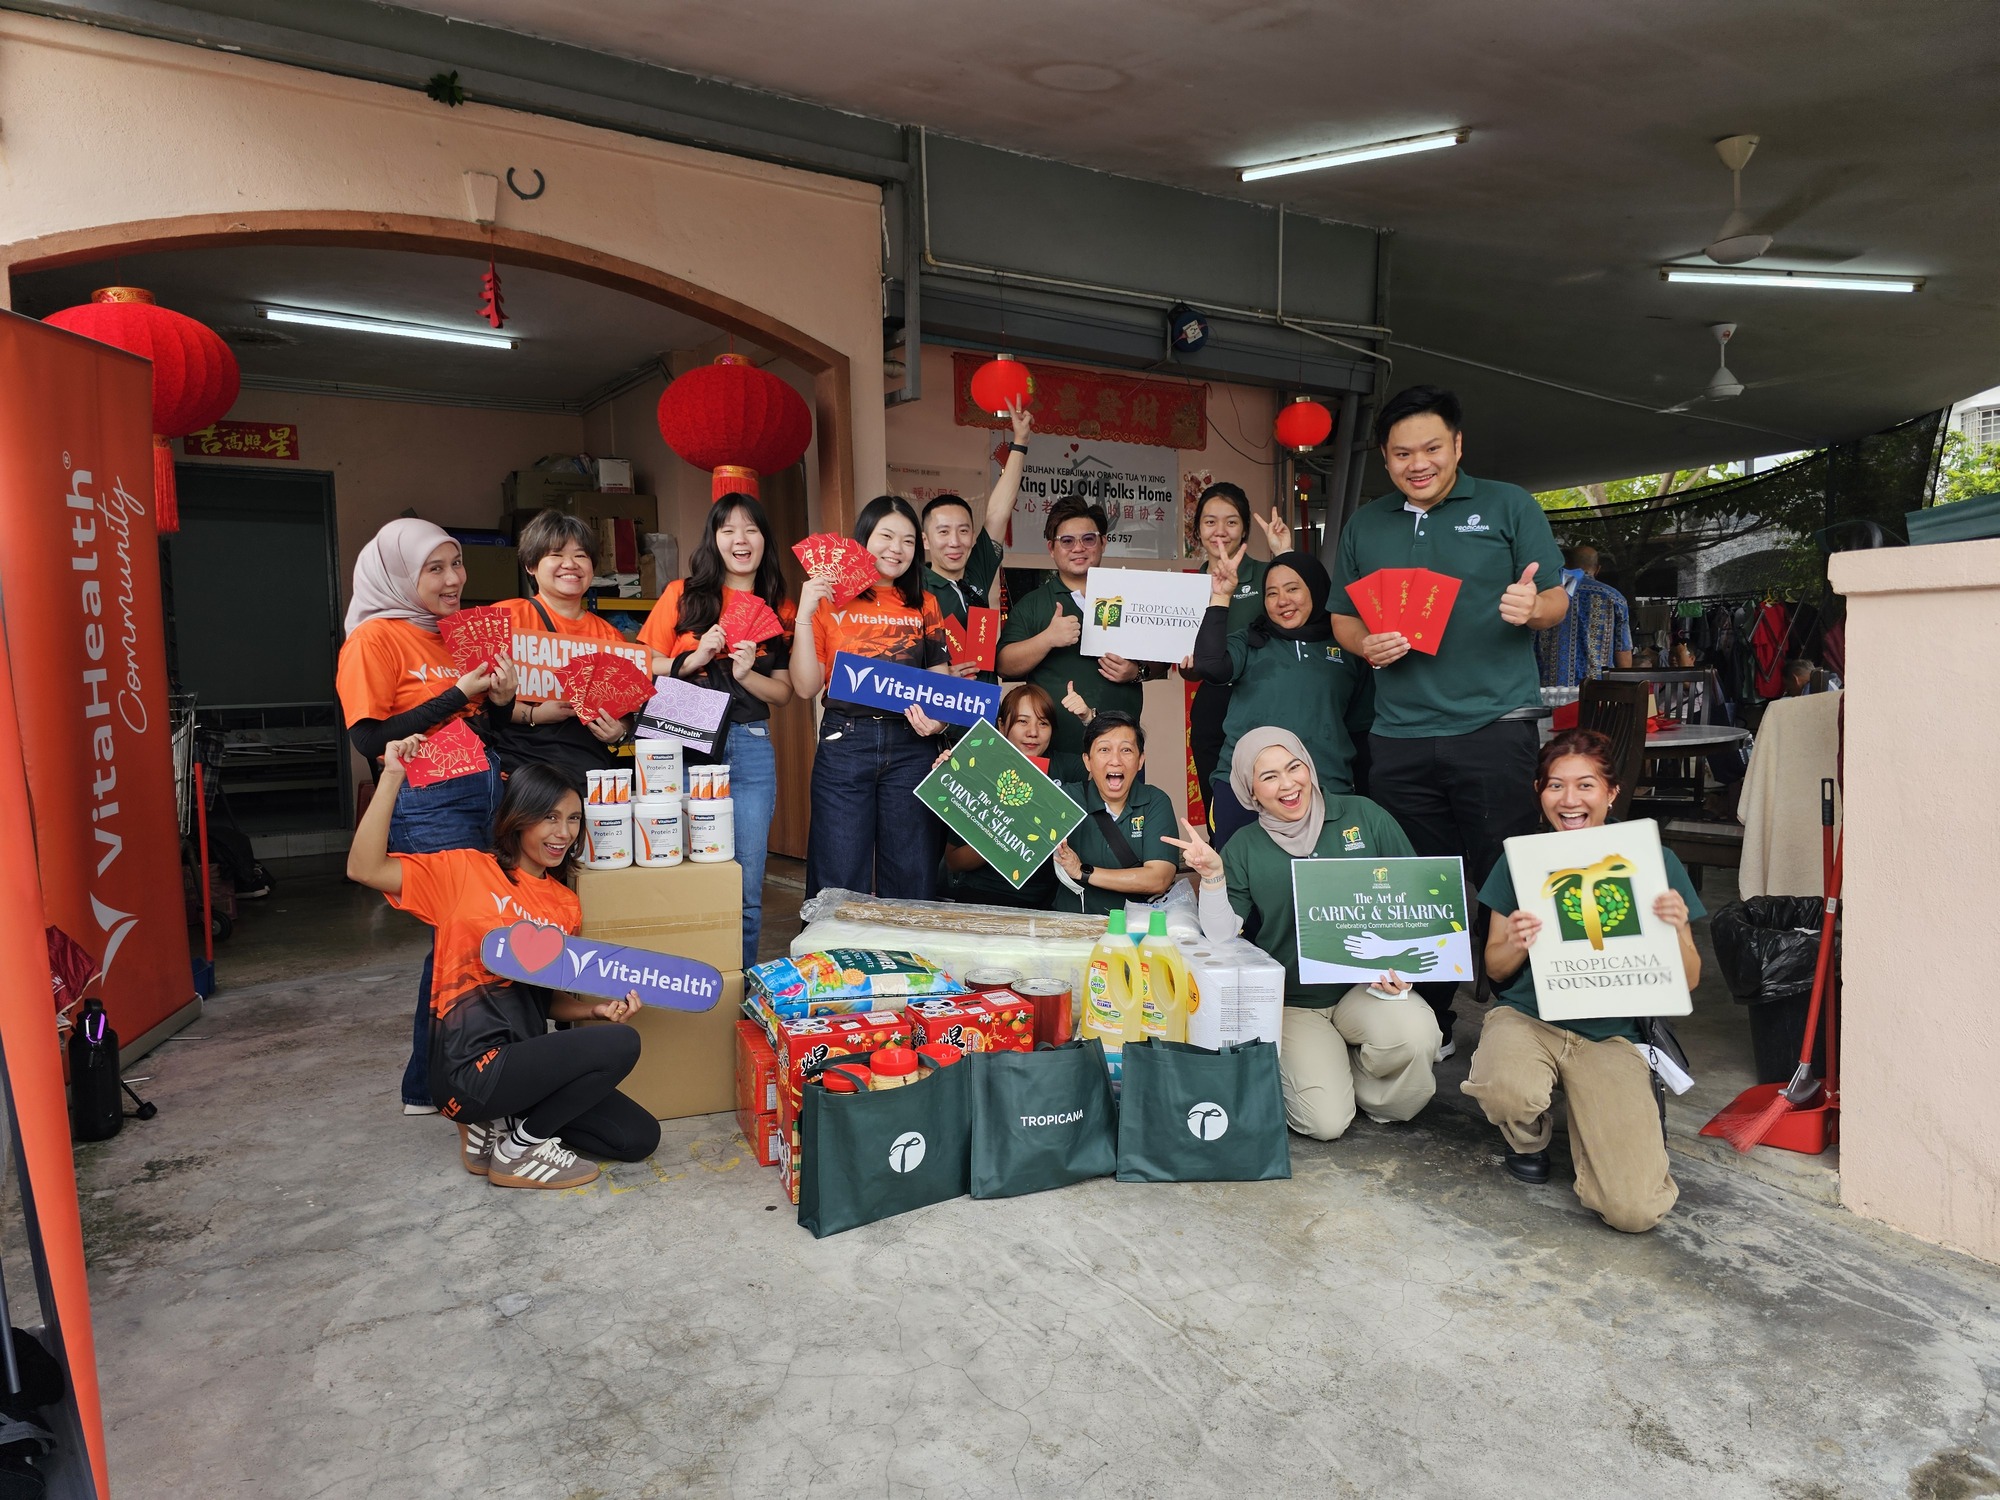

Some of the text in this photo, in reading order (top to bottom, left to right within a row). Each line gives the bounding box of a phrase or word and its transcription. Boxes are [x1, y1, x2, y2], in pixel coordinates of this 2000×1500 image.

[1057, 467, 1095, 478] KEBAJIKAN
[1097, 471, 1123, 480] ORANG
[1125, 473, 1139, 481] TUA
[1140, 474, 1147, 482] YI
[1148, 475, 1166, 484] XING
[1050, 479, 1074, 495] USJ
[1077, 482, 1100, 497] Old
[1103, 483, 1135, 500] Folks
[1138, 485, 1172, 503] Home
[1454, 524, 1490, 532] TROPICANA
[1118, 534, 1133, 543] 757
[97, 476, 148, 733] Community
[1131, 603, 1196, 616] TROPICANA
[849, 613, 922, 629] VitaHealth
[1125, 615, 1200, 628] FOUNDATION
[978, 790, 1015, 825] The Art of
[940, 773, 1036, 863] CARING & SHARING
[950, 797, 1010, 853] Celebrating Communities Together
[1353, 892, 1407, 904] The Art of
[1308, 904, 1455, 921] CARING & SHARING
[1335, 921, 1429, 930] Celebrating Communities Together
[1550, 954, 1662, 973] TROPICANA
[1090, 981, 1106, 989] Dettol
[1546, 971, 1673, 991] FOUNDATION
[1020, 1109, 1084, 1127] TROPICANA
